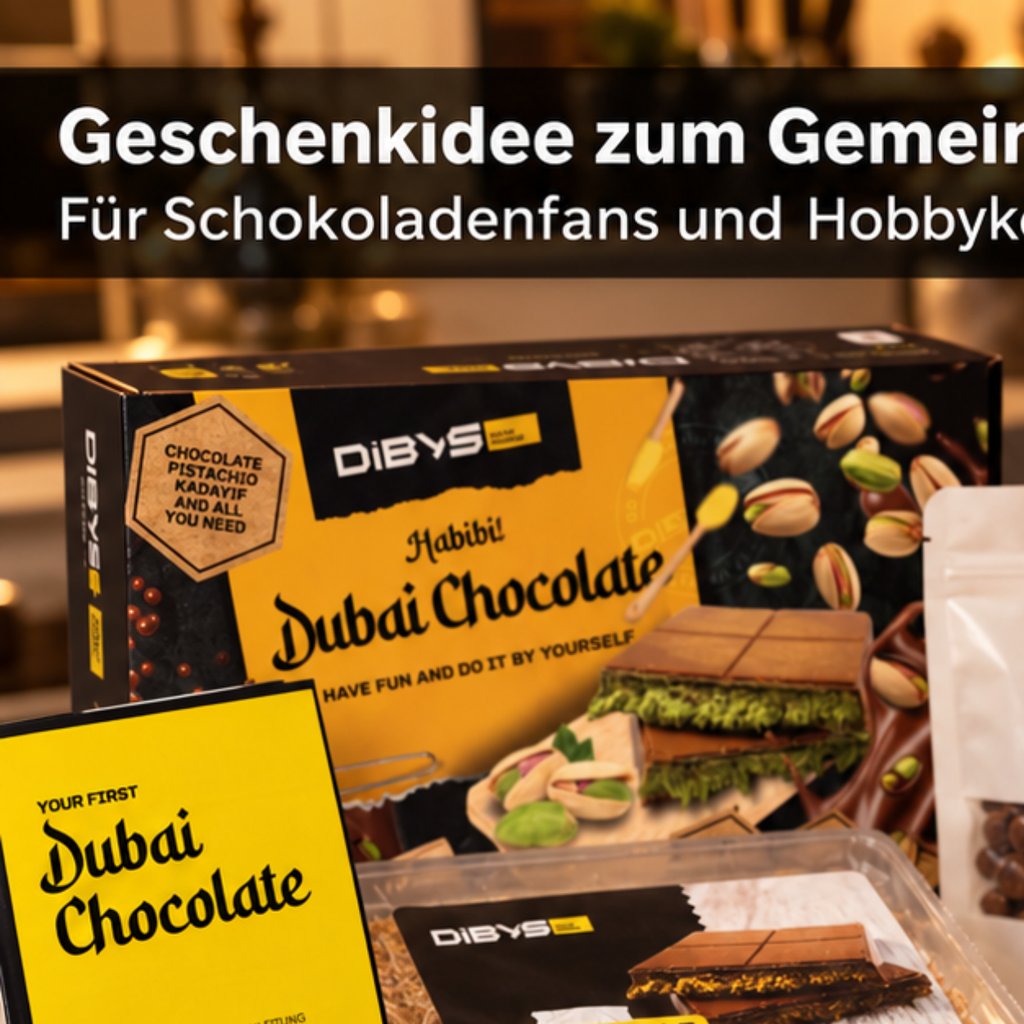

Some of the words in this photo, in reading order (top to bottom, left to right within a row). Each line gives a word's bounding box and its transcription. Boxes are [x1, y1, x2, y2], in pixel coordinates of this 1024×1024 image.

[164, 443, 263, 471] CHOCOLATE
[167, 461, 258, 486] PISTACHIO
[174, 479, 248, 501] KADAYIF
[174, 495, 209, 513] AND
[212, 501, 244, 518] ALL
[165, 509, 200, 527] YOU
[202, 515, 247, 535] NEED
[405, 517, 507, 564] Habibi!
[272, 582, 430, 671] Dubai
[430, 546, 673, 629] Chocolate
[323, 681, 372, 703] HAVE
[375, 672, 413, 693] FUN
[416, 664, 456, 684] AND
[458, 656, 484, 677] DO
[487, 654, 508, 671] IT
[511, 647, 537, 667] BY
[540, 629, 635, 660] YOURSELF
[37, 794, 84, 814] YOUR
[87, 785, 138, 806] FIRST
[40, 808, 204, 894] Dubai
[55, 864, 312, 956] Chocolate
